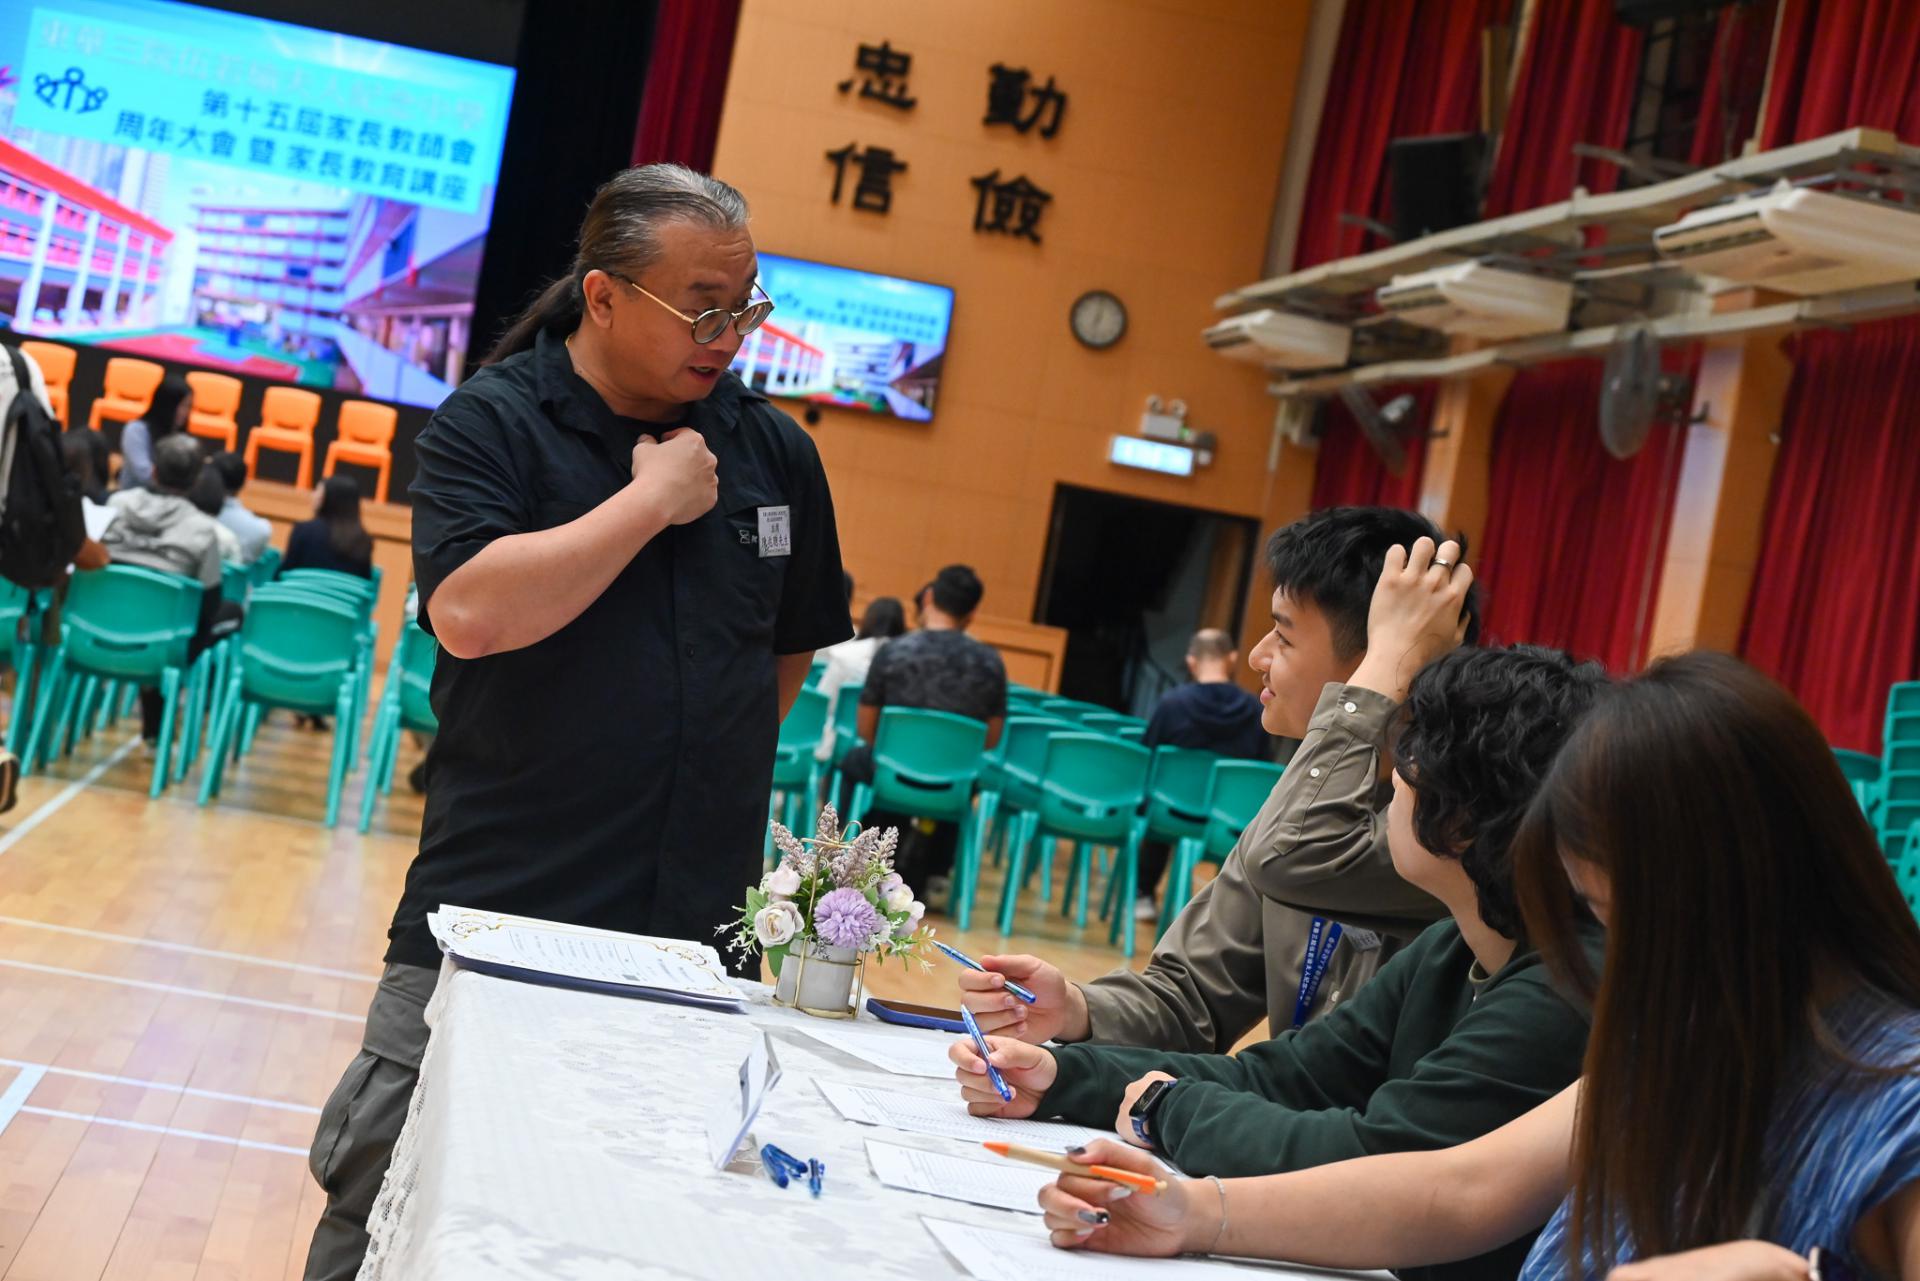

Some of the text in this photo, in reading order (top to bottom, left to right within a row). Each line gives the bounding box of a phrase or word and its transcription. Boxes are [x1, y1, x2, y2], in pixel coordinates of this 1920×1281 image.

[114, 110, 470, 203] 周年大會 暨 家長教育講座
[202, 88, 476, 166] 第十五屆家長教師會
